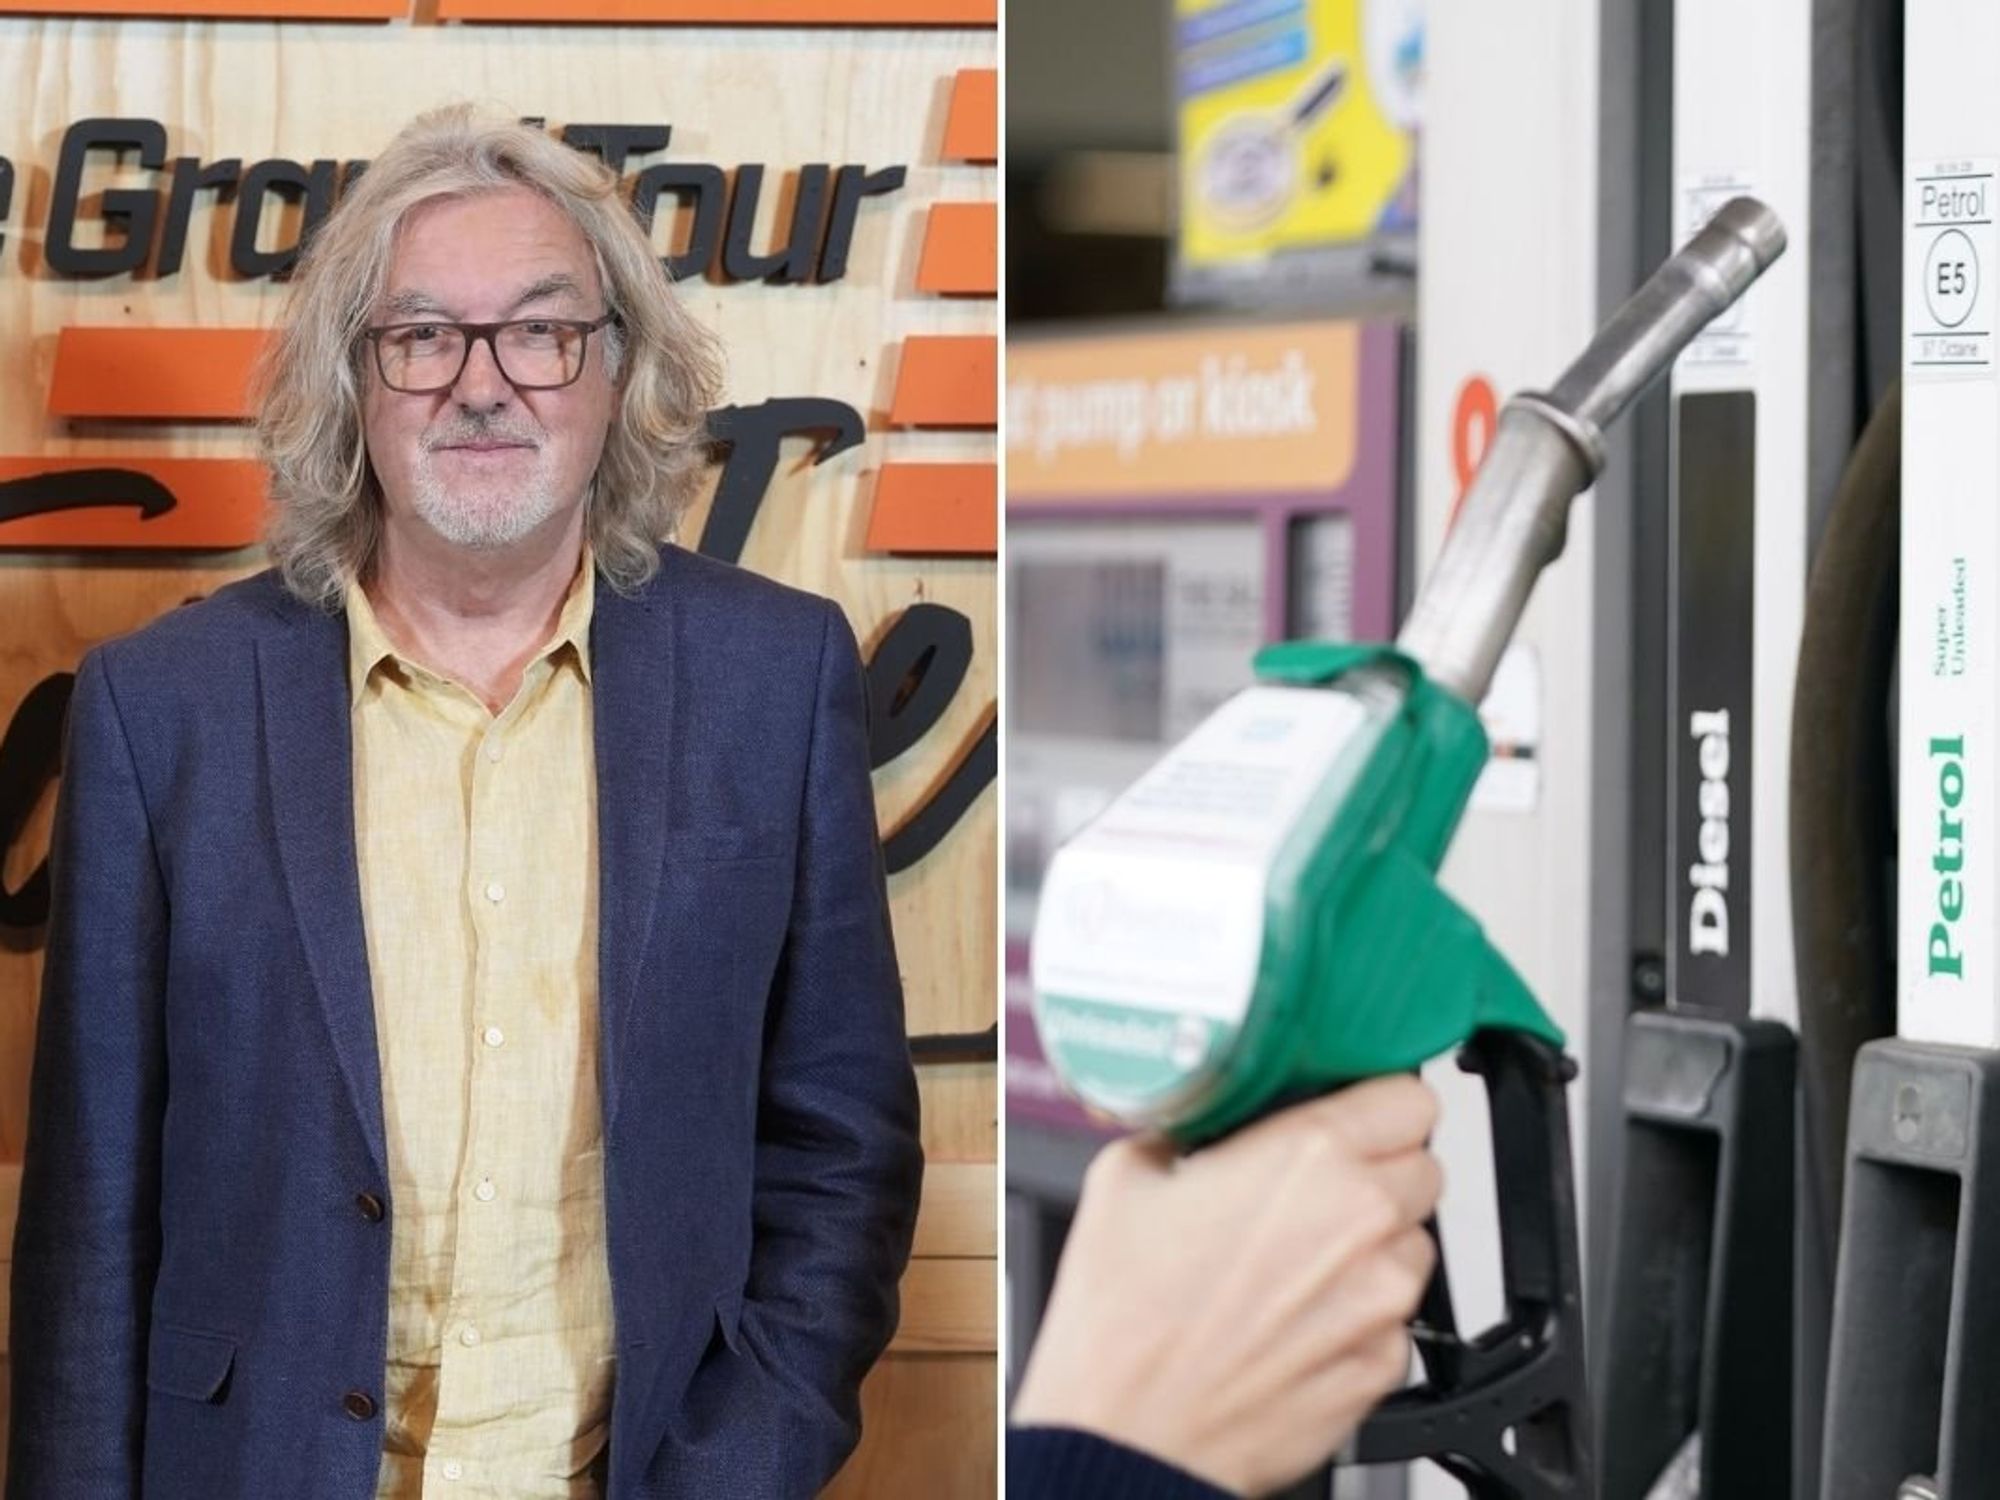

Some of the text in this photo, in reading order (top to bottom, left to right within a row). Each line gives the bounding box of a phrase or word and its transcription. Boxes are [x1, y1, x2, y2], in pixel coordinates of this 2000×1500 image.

[1922, 183, 1985, 217] Petrol
[1937, 261, 1966, 295] E5
[1199, 349, 1317, 438] kiosk
[1935, 606, 1949, 676] Super
[1951, 557, 1965, 676] Unleaded
[1688, 708, 1730, 956] Diesel
[1927, 734, 1964, 980] Petrol
